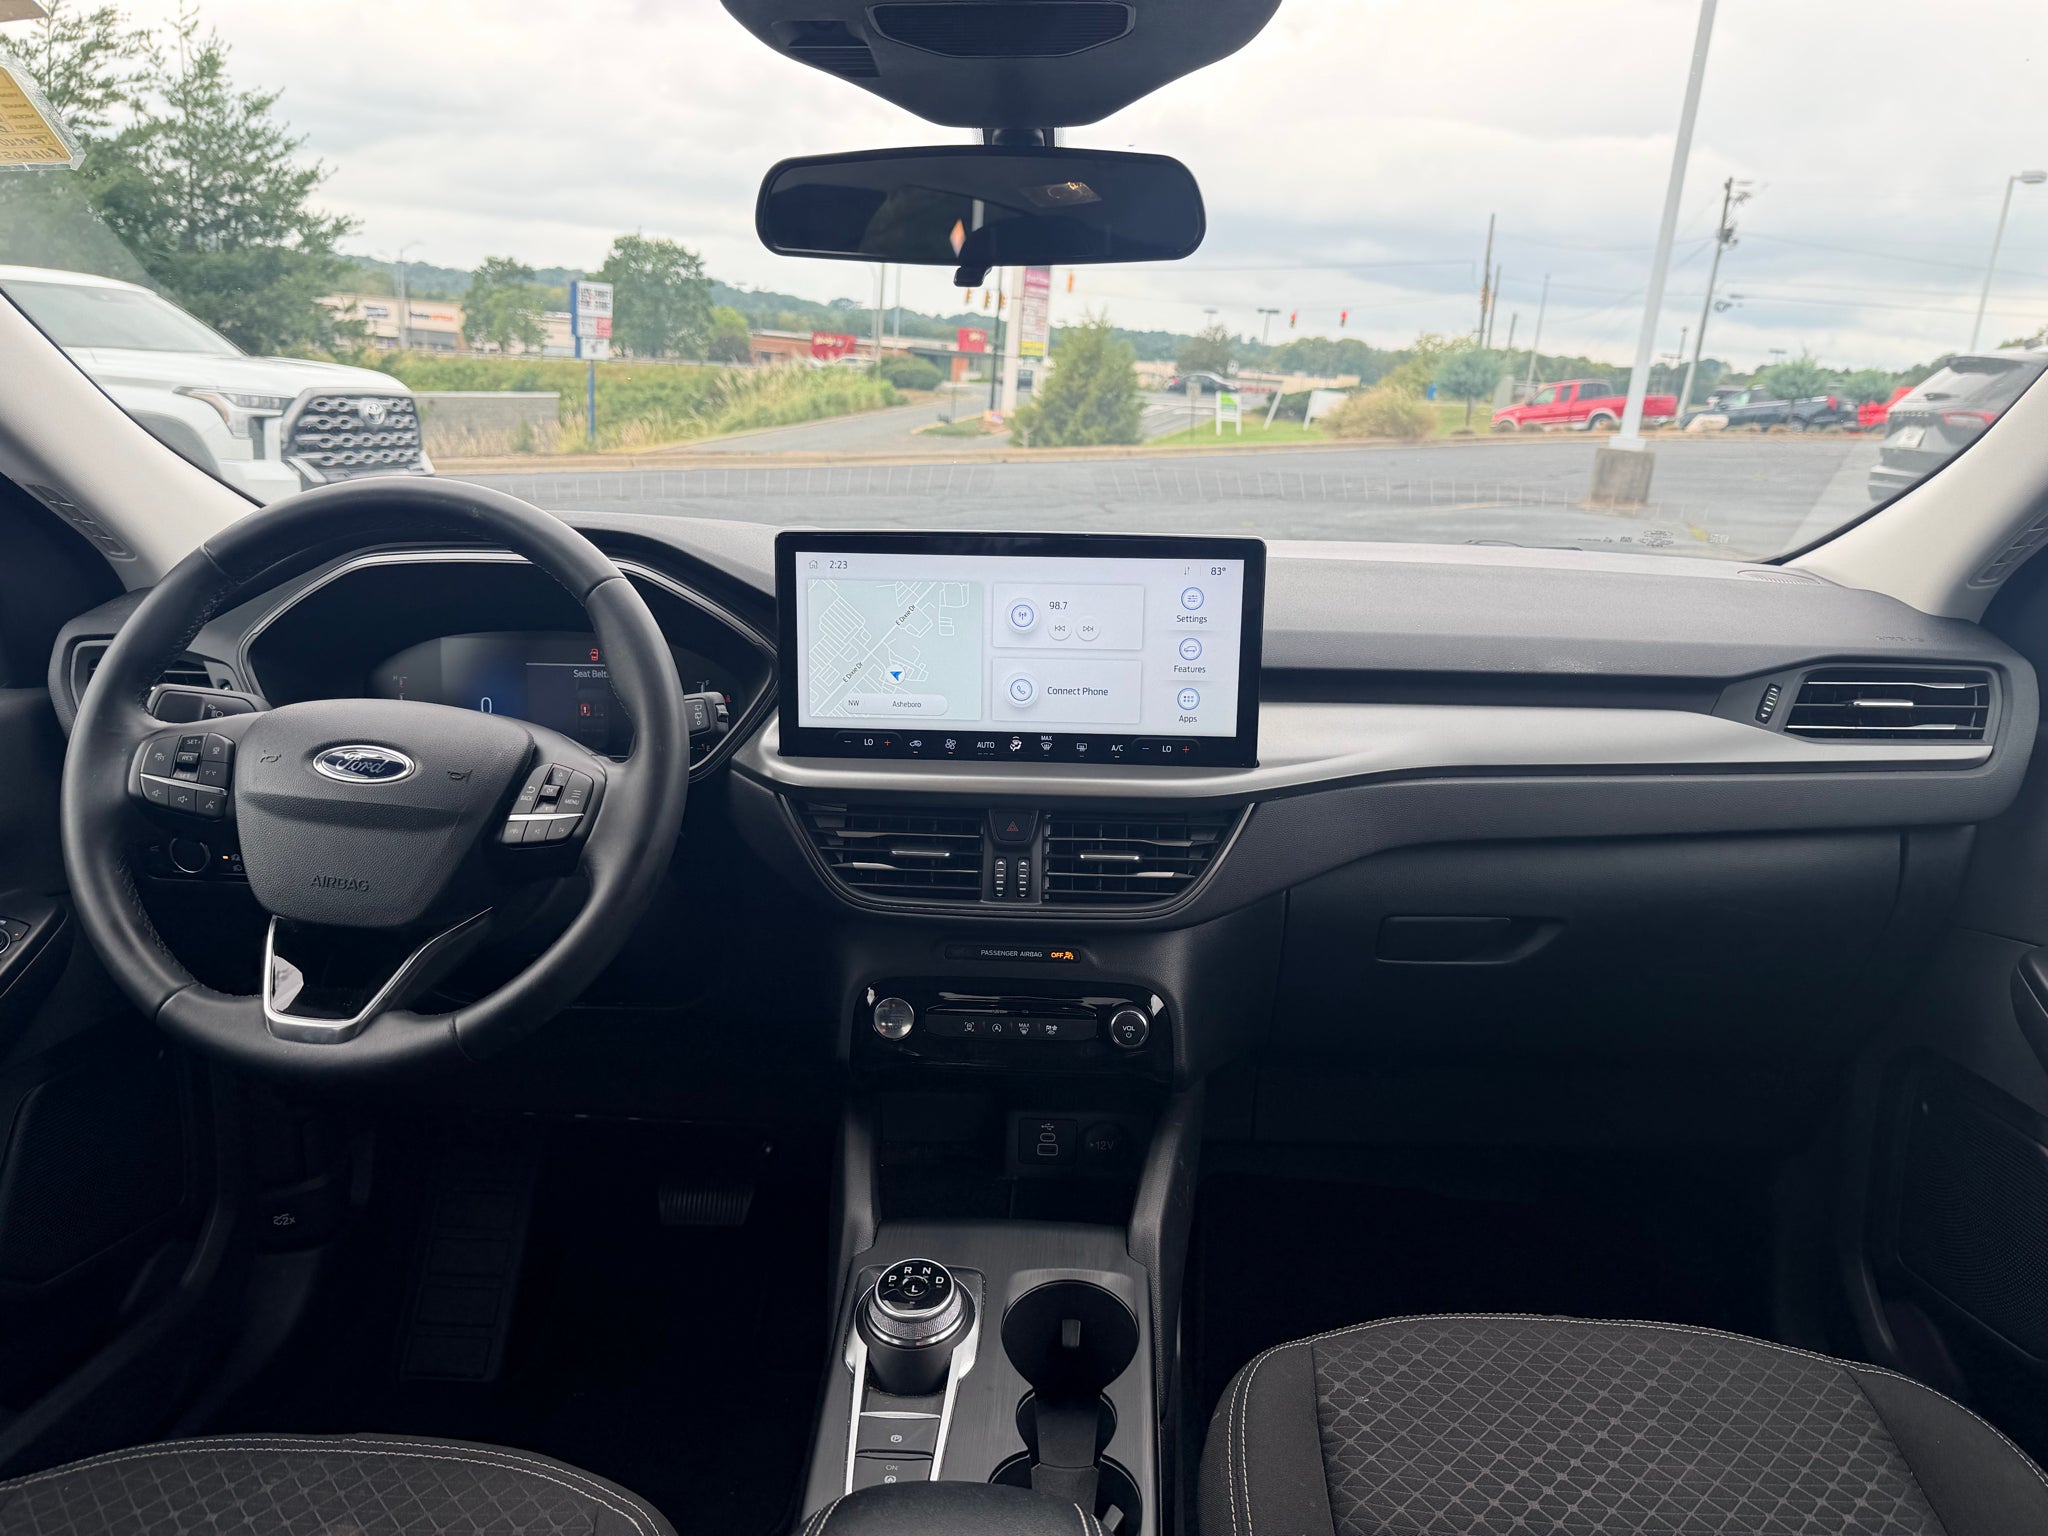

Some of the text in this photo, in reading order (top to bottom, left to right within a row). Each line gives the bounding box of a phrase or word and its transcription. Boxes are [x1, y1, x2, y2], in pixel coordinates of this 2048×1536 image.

[829, 560, 848, 570] 2:23
[1049, 601, 1068, 611] 98.7
[1176, 614, 1208, 624] Settings
[573, 669, 609, 679] Seat Belt
[1173, 664, 1206, 674] Features
[1047, 686, 1109, 697] Connect Phone
[848, 699, 860, 707] NW
[892, 699, 922, 709] Asheboro
[1178, 714, 1198, 724] Apps
[864, 738, 874, 747] LO
[976, 740, 995, 749] AUTO
[1111, 744, 1124, 753] A/C
[1162, 745, 1172, 754] LO
[335, 751, 388, 775] Ford
[564, 798, 580, 806] MENU
[310, 875, 370, 892] AIRBAG
[980, 949, 1018, 957] PASSENGER
[888, 1266, 944, 1284] P R N D
[911, 1285, 918, 1293] L
